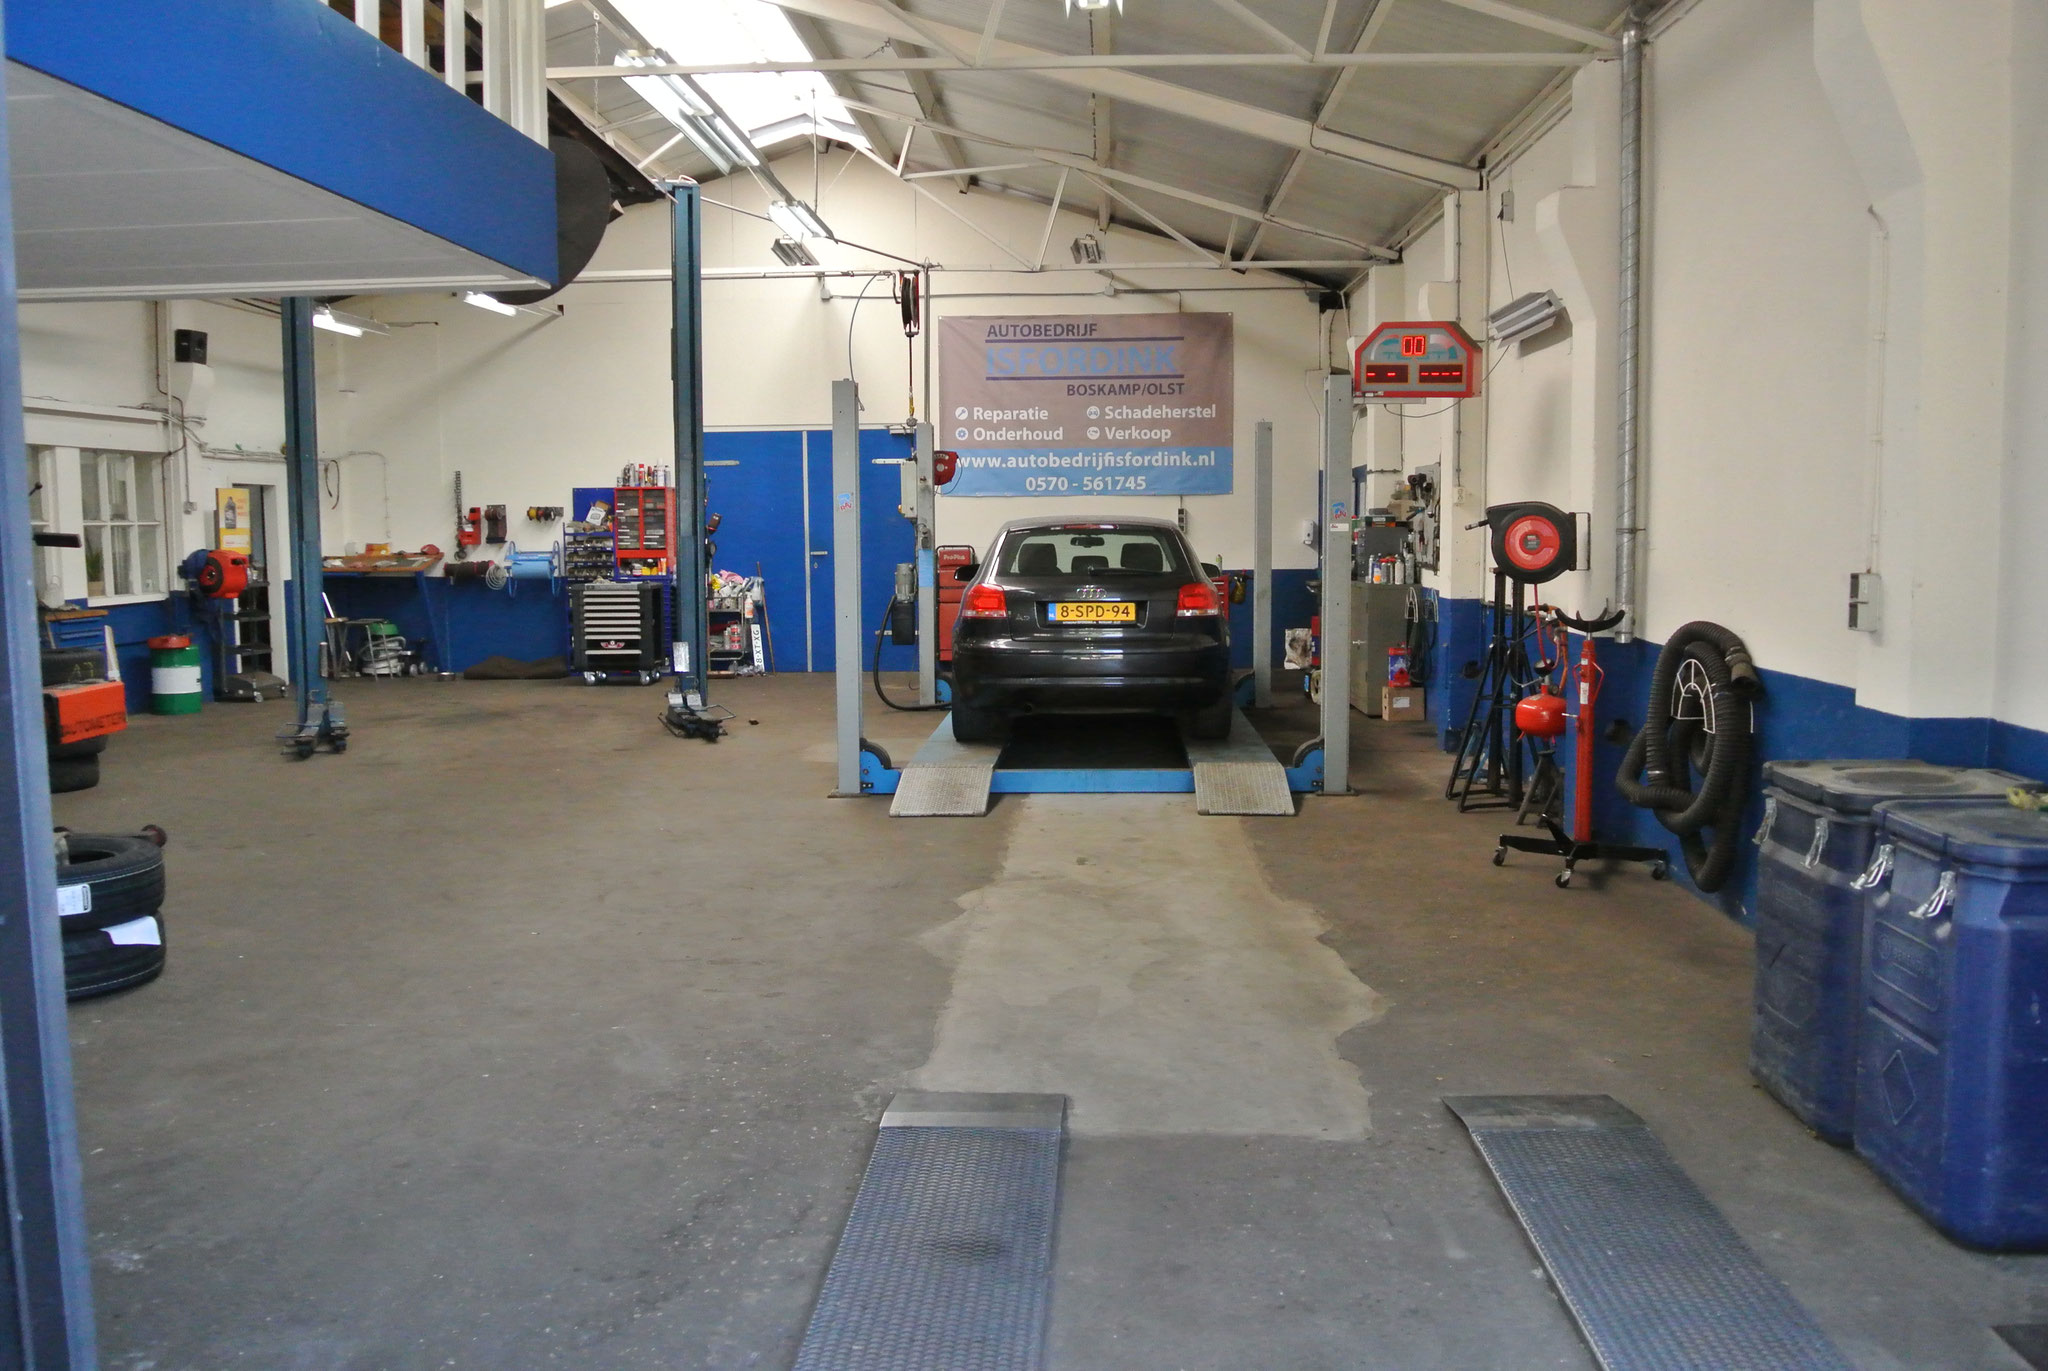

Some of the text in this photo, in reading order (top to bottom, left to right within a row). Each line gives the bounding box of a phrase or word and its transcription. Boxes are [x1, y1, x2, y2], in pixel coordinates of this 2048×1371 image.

[987, 323, 1098, 338] AUTOBEDRIJF
[986, 345, 1177, 374] ISFORDINK
[1066, 382, 1185, 397] BOSKAMP/OLST
[973, 406, 1049, 422] Reparatie
[1104, 404, 1216, 420] Schadeherstel
[973, 427, 1064, 441] Onderhoud
[1105, 426, 1172, 442] Verkoop
[957, 451, 1215, 471] www.autobedrijfisfordink.nl
[1025, 476, 1069, 491] 0570
[1082, 475, 1147, 491] 561745
[1060, 605, 1130, 618] 8-SPD-94
